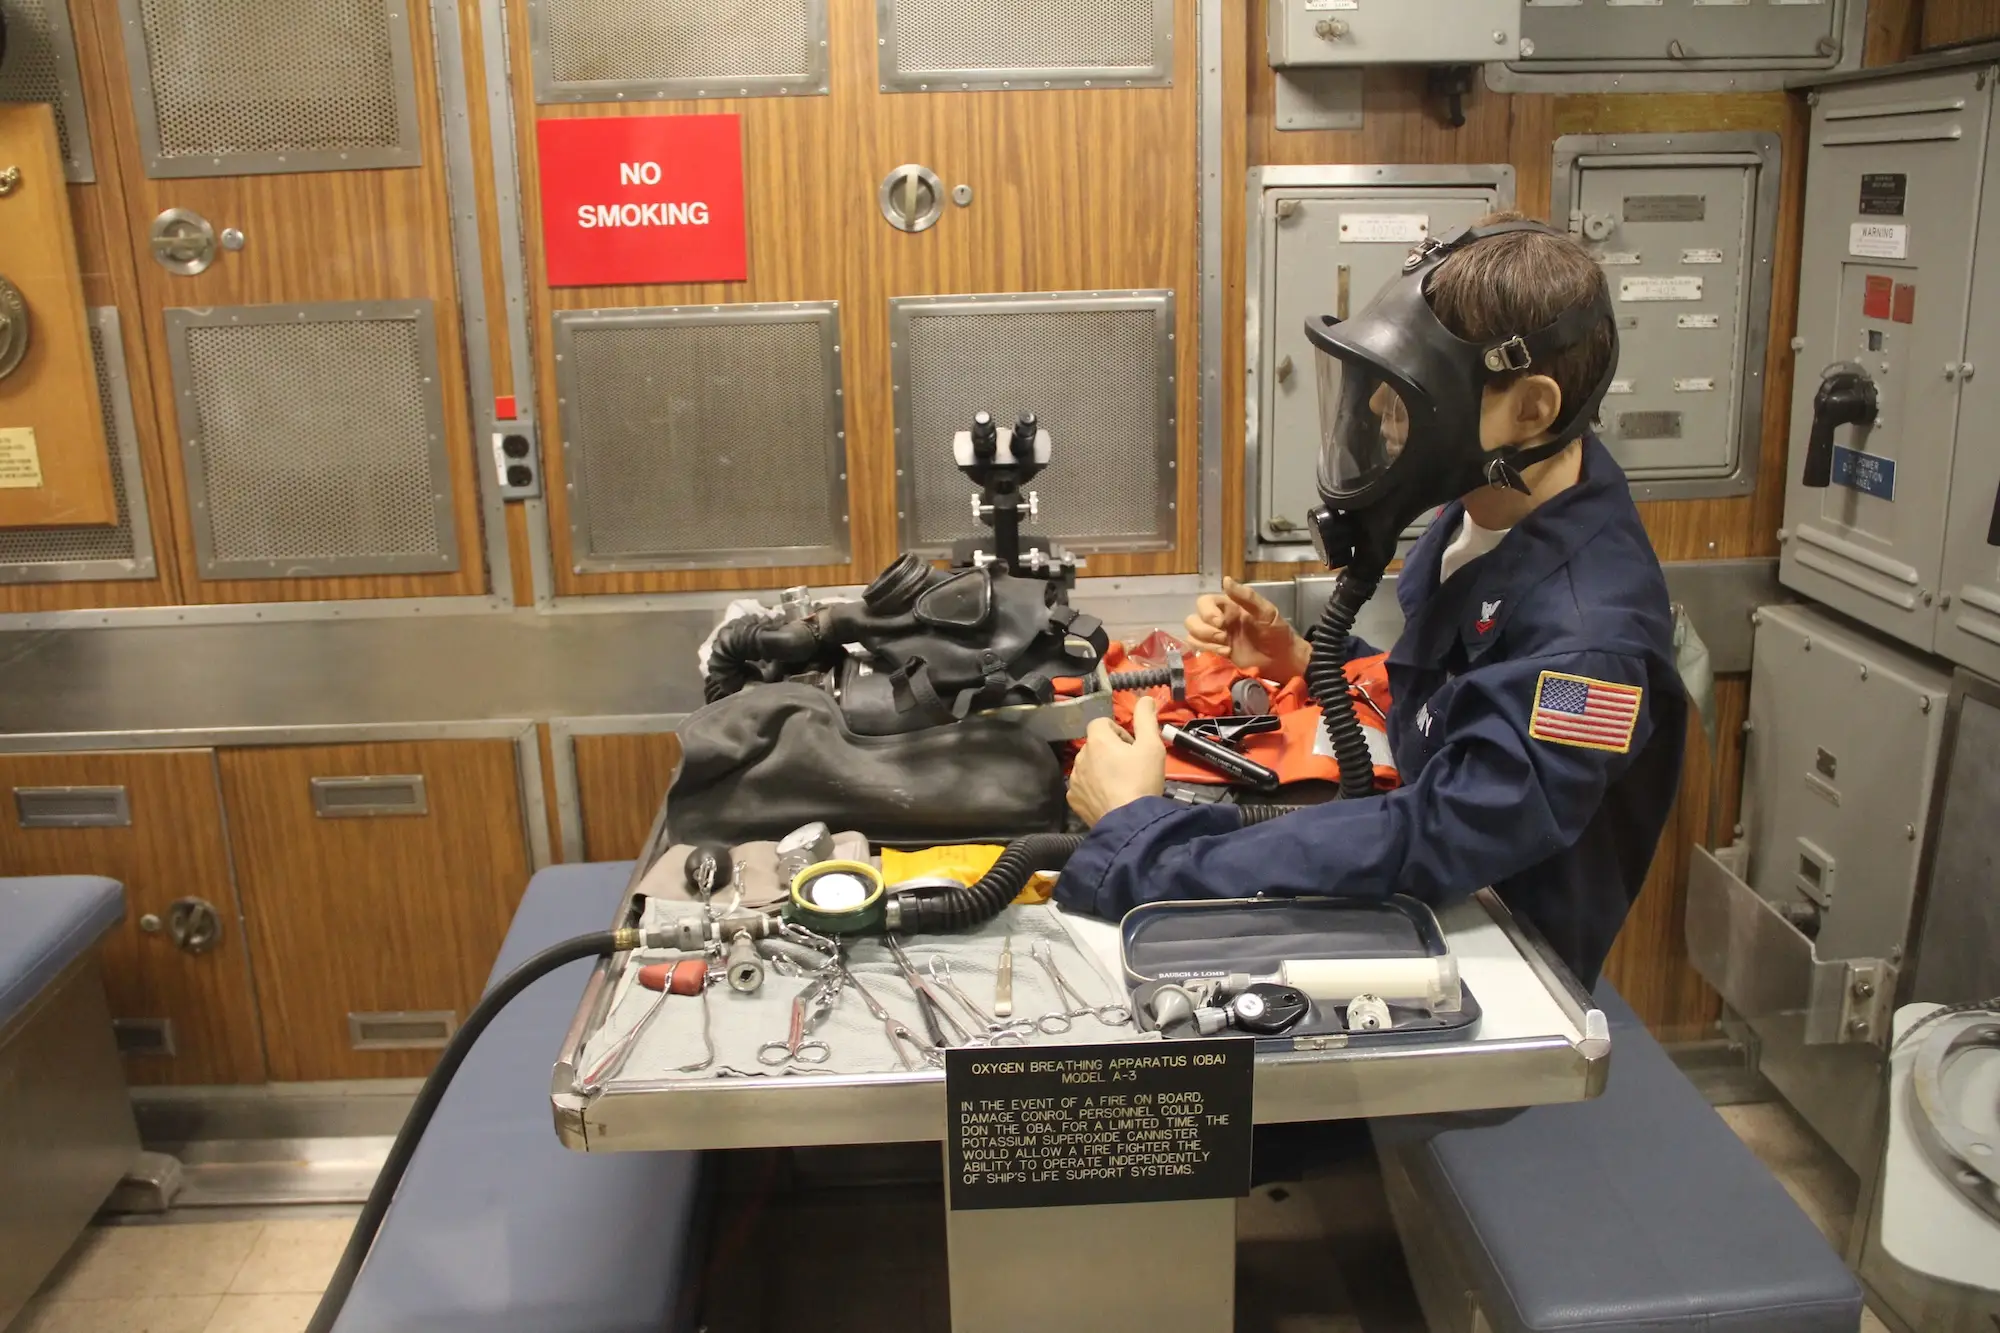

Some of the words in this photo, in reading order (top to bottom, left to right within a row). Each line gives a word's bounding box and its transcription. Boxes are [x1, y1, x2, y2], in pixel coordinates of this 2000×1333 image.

[619, 161, 662, 185] NO
[577, 202, 709, 228] SMOKING
[1861, 226, 1894, 239] WARNING
[1158, 971, 1191, 979] BAUSCH
[972, 1062, 1024, 1075] OXYGEN
[1030, 1059, 1103, 1072] BREATHING
[1109, 1055, 1187, 1069] APPARATUS
[1193, 1054, 1226, 1066] (OBA)
[1062, 1072, 1106, 1083] MODEL
[1112, 1070, 1137, 1082] A-3
[961, 1101, 973, 1112] IN
[979, 1099, 1005, 1111] THE
[1011, 1098, 1054, 1110] EVENT
[1061, 1097, 1078, 1108] OF
[1084, 1097, 1094, 1107] A
[1100, 1095, 1127, 1106] FIRE
[1134, 1094, 1152, 1105] ON
[961, 1111, 1015, 1124] DAMAGE
[1021, 1109, 1073, 1122] CONROL
[1079, 1106, 1154, 1120] PERSONNEL
[1161, 1104, 1203, 1116] COULD
[962, 1124, 988, 1136] DON
[994, 1123, 1020, 1135] THE
[1062, 1121, 1088, 1132] FOR
[1094, 1121, 1103, 1131] A
[1109, 1117, 1159, 1130] LIMITED
[1166, 1116, 1199, 1128] TIME,
[1205, 1114, 1229, 1126] THE
[962, 1135, 1036, 1149] POTASSIUM
[1042, 1131, 1120, 1145] SUPEROXIDE
[1127, 1128, 1198, 1142] CANNISTER
[962, 1148, 1009, 1161] WOULD
[1015, 1146, 1062, 1159] ALLOW
[1068, 1146, 1077, 1156] A
[1084, 1144, 1111, 1155] FIRE
[1117, 1141, 1170, 1154] FIGHTER
[1177, 1140, 1201, 1151] THE
[963, 1160, 1012, 1172] ABILITY
[1019, 1159, 1037, 1170] TO
[1043, 1156, 1102, 1169] OPERATE
[1109, 1151, 1210, 1166] INDEPENDENTLY
[963, 1173, 980, 1184] OF
[986, 1172, 1026, 1184] SHIP'S
[1032, 1170, 1059, 1182] LIFE
[1066, 1167, 1125, 1180] SUPPORT
[1131, 1164, 1194, 1177] SYSTEMS.
